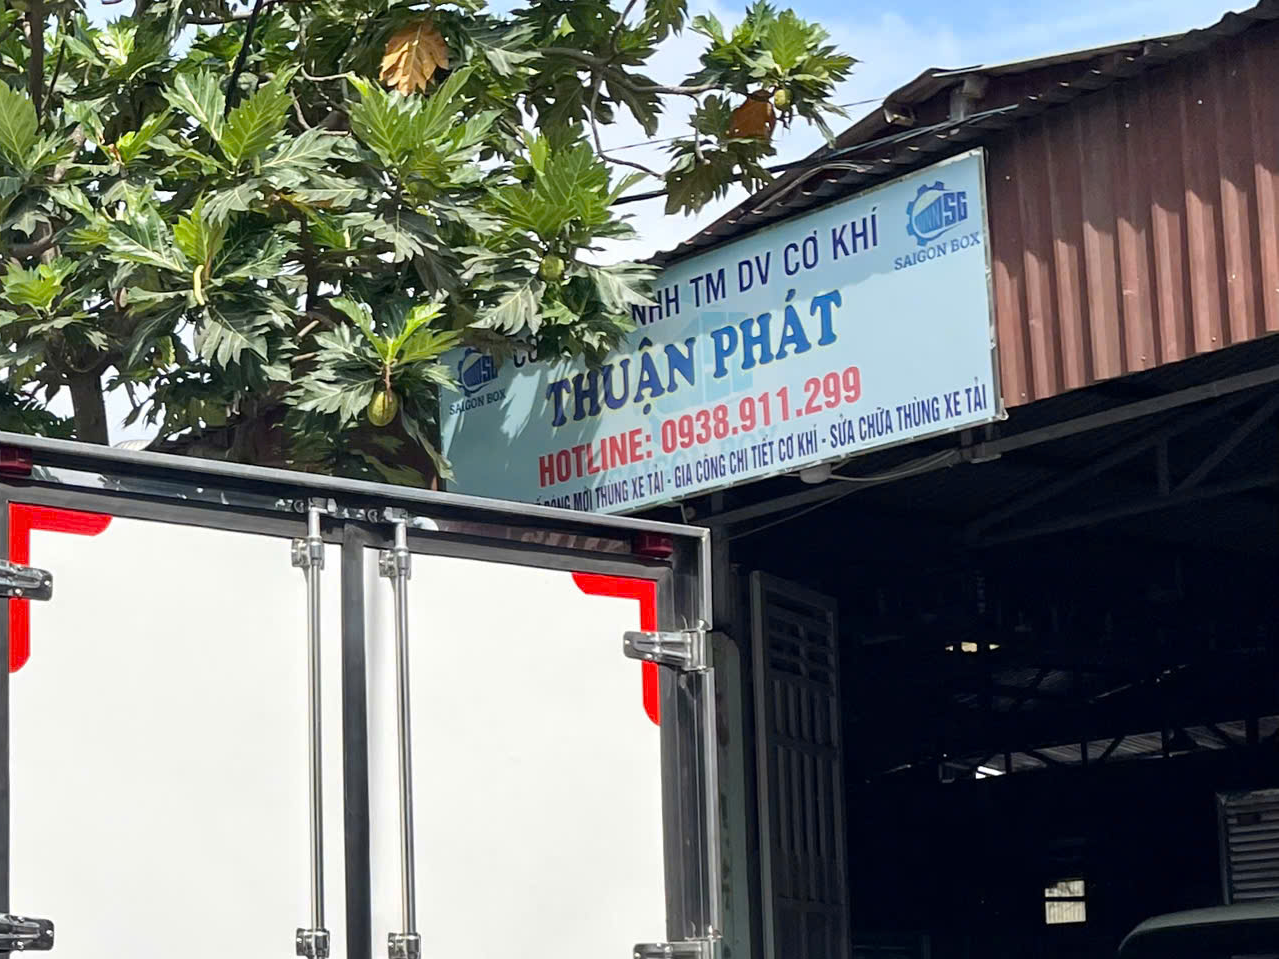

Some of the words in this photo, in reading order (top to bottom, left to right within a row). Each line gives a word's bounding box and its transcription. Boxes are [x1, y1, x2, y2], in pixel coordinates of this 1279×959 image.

[631, 284, 680, 326] NHH
[689, 268, 727, 308] TM
[738, 251, 771, 293] DV
[784, 230, 819, 276] CƠ
[832, 206, 878, 261] KHÍ
[894, 242, 947, 271] SAIGON
[950, 231, 981, 253] BOX
[449, 395, 485, 416] SAIGON
[486, 388, 507, 405] BOX
[546, 336, 696, 428] THUẬN
[710, 288, 843, 379] PHÁT
[539, 427, 654, 488] HOTLINE:
[661, 365, 862, 454] 0938.911.299
[594, 480, 629, 509] THÙNG
[631, 475, 645, 500] XE
[648, 463, 665, 495] TẢI
[674, 463, 693, 489] GIA
[695, 453, 726, 484] CÔNG
[729, 447, 748, 475] CHI
[751, 434, 774, 470] TIẾT
[778, 432, 795, 462] CƠ
[797, 424, 819, 457] KHÍ
[830, 413, 857, 449] SỬA
[858, 406, 894, 441] CHỮA
[896, 395, 941, 432] THÙNG
[943, 391, 962, 419] XE
[965, 377, 988, 412] TẢI
